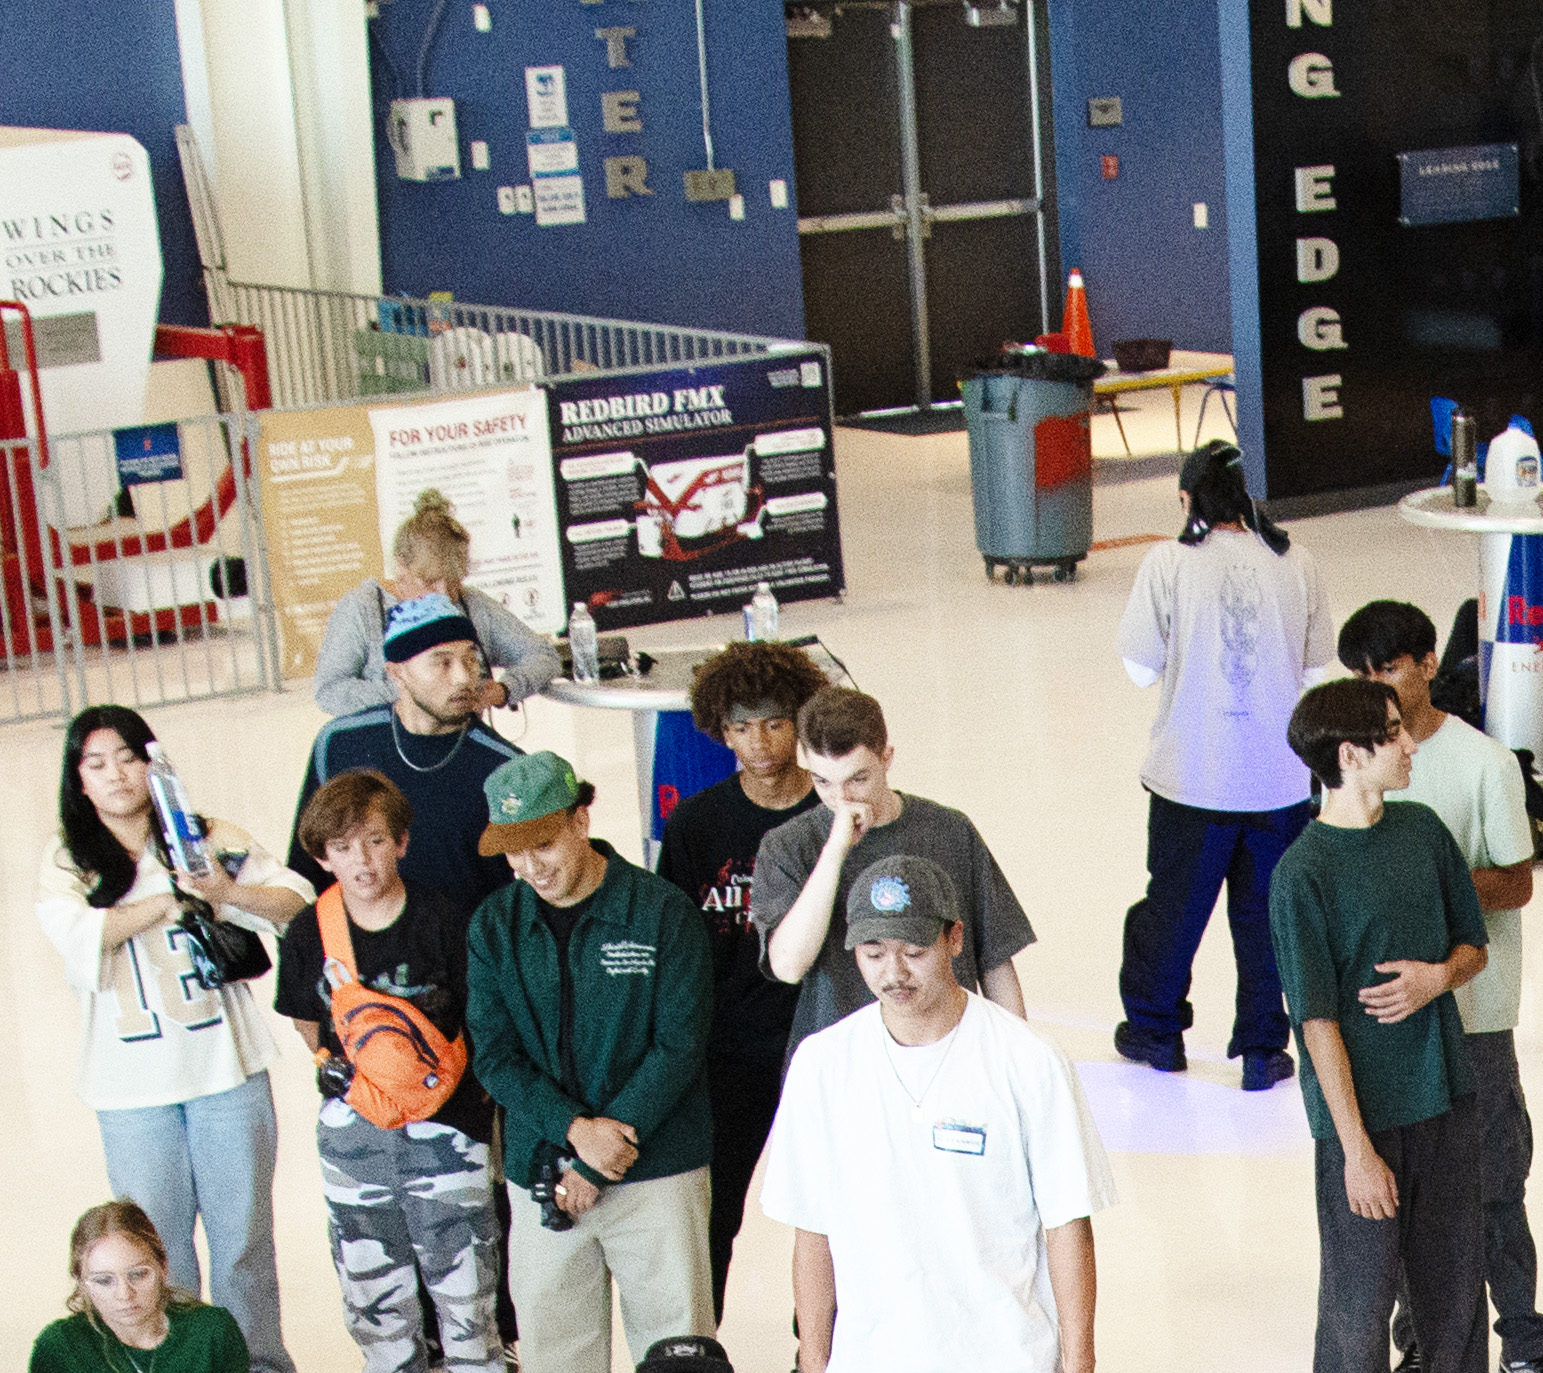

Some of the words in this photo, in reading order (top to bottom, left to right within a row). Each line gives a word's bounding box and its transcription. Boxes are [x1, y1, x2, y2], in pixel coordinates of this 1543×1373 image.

[593, 0, 654, 199] TER
[2, 209, 117, 241] WINGS
[5, 248, 67, 269] OVER
[72, 242, 118, 262] THE
[11, 267, 123, 302] ROCKIES
[1293, 164, 1350, 422] EDGE
[560, 389, 672, 425] REDBIRD
[675, 385, 726, 411] FMX
[388, 427, 424, 447] FOR
[425, 421, 470, 442] YOUR
[472, 414, 527, 437] SAFETY
[562, 417, 641, 444] ADVANCED
[643, 408, 734, 434] SIMULATOR
